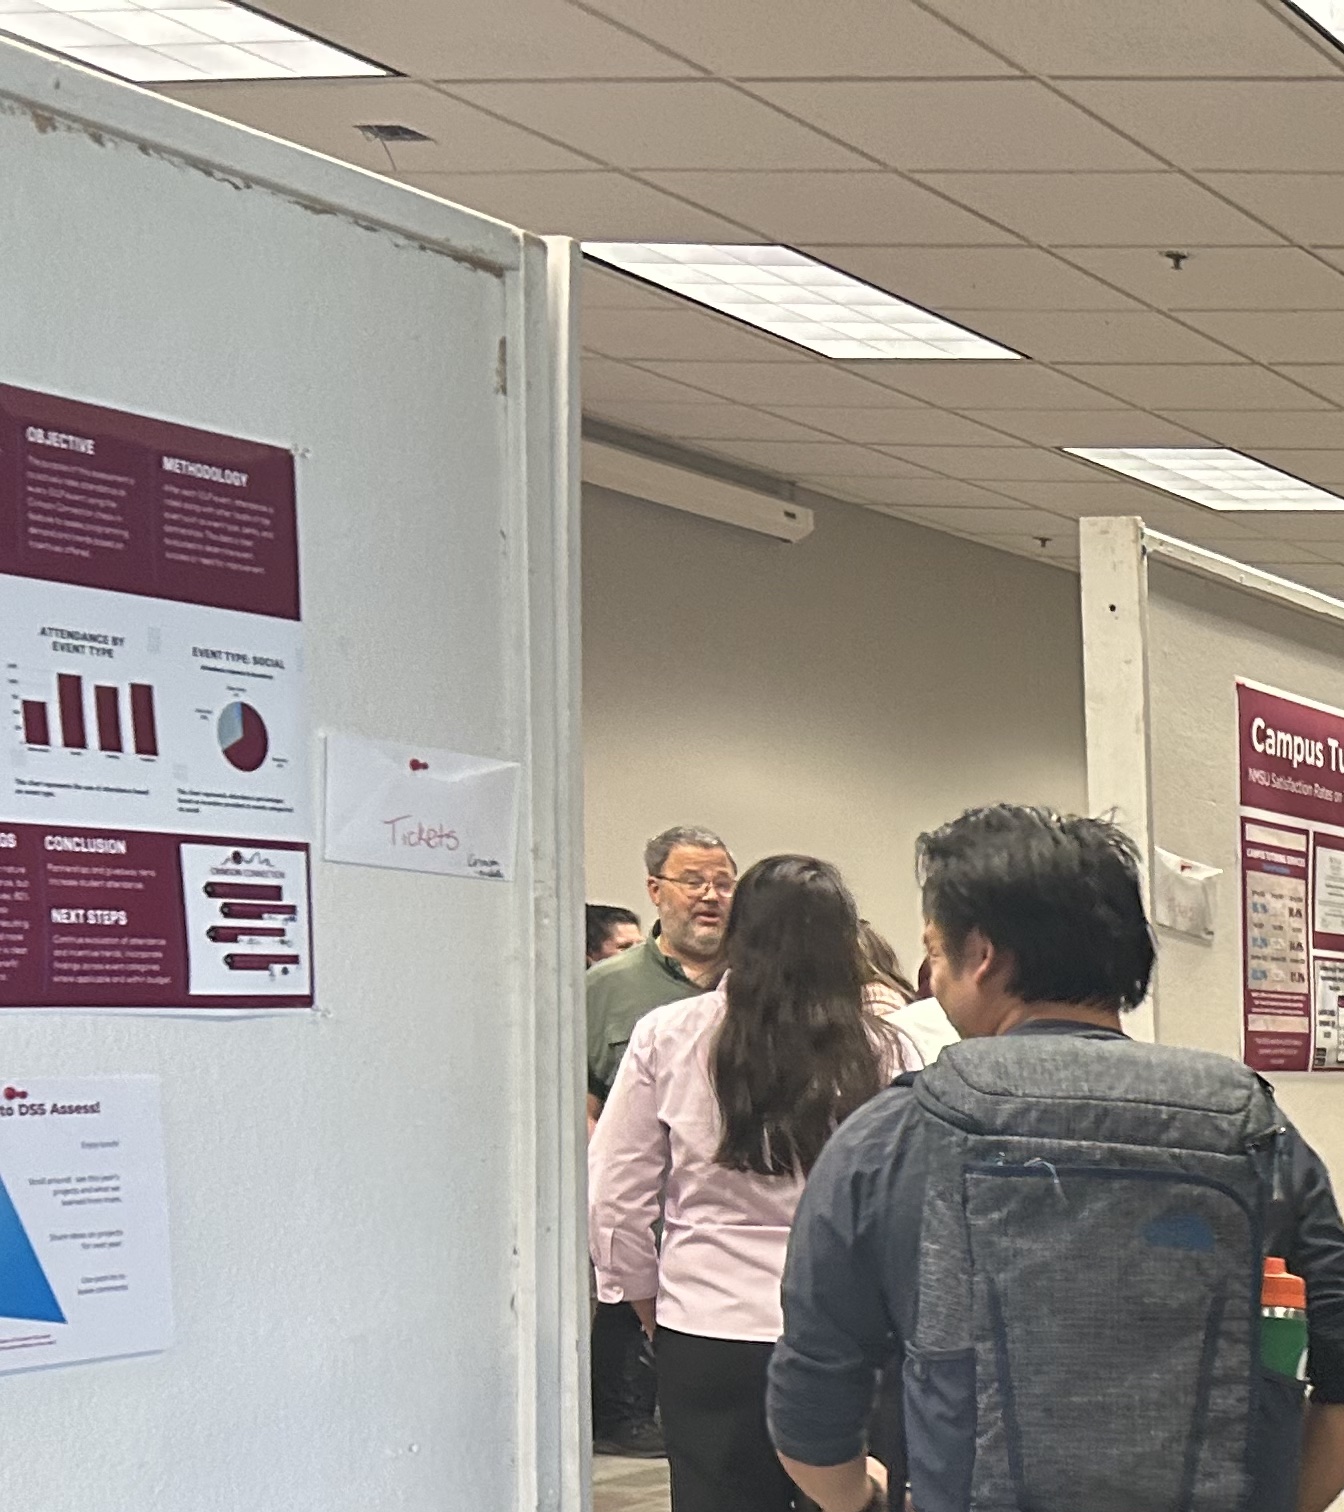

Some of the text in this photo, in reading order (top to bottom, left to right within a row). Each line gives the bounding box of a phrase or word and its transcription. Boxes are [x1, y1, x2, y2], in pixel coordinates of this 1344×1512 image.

[25, 425, 95, 455] OBJECTIVE
[161, 456, 248, 487] METHODOLOGY
[39, 626, 126, 647] ATTENDANCE BY
[51, 641, 115, 659] EVENT TYPE
[192, 647, 223, 661] EVENT
[252, 655, 286, 670] SOCIAL
[1251, 717, 1324, 768] Campus
[1271, 772, 1313, 796] Satisfaction
[1313, 783, 1333, 802] Rates
[382, 814, 459, 851] Tickets
[44, 835, 127, 855] CONCLUSION
[51, 908, 128, 925] NEXT STEPS
[0, 1101, 101, 1117] to DSS Assess!
